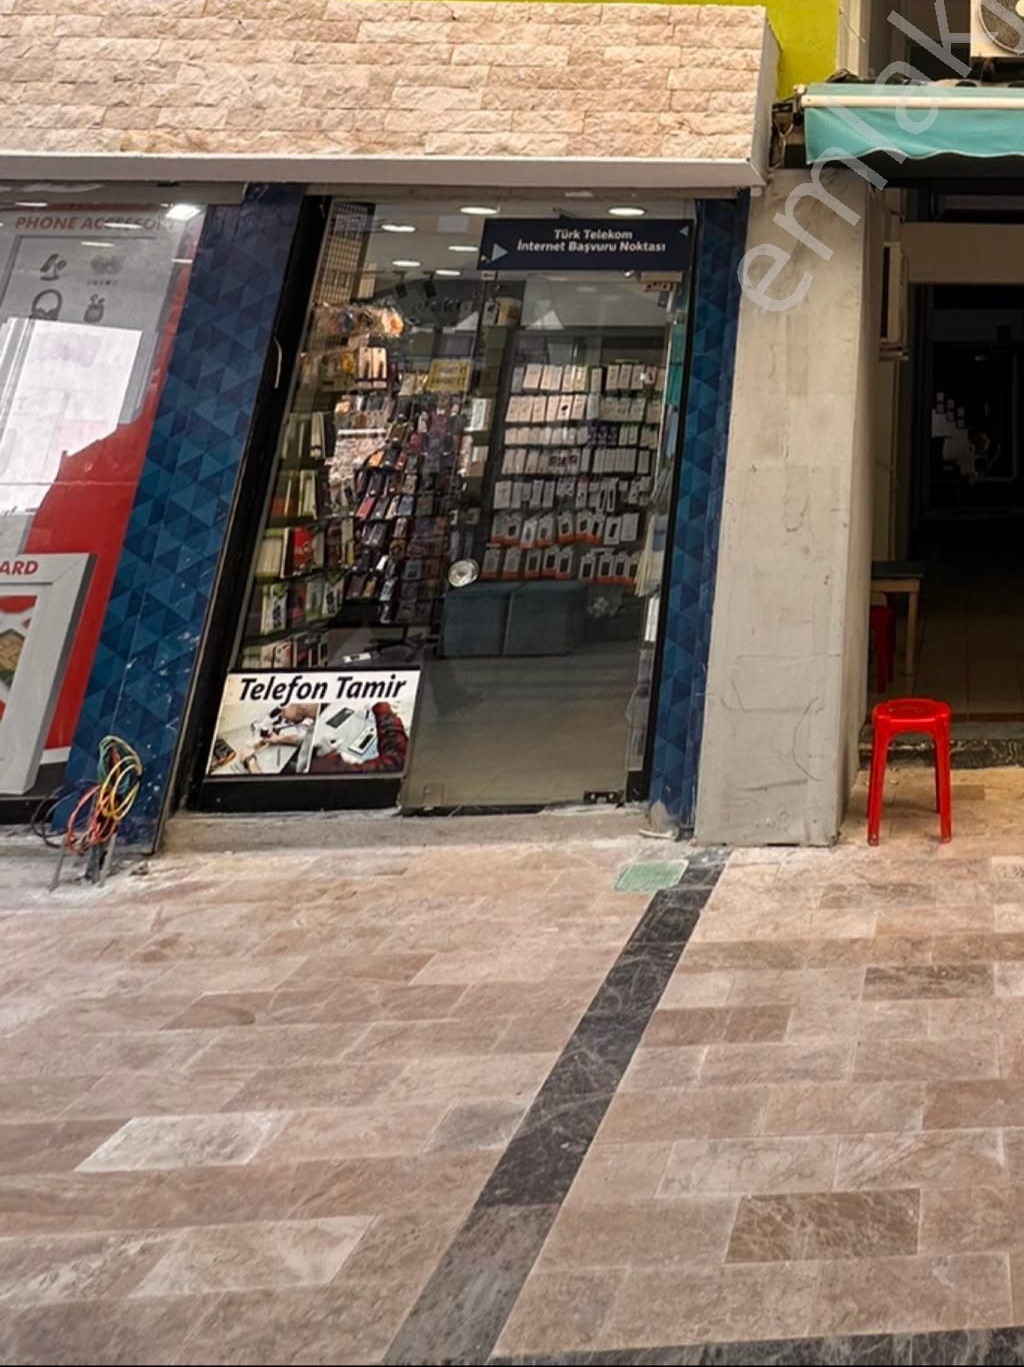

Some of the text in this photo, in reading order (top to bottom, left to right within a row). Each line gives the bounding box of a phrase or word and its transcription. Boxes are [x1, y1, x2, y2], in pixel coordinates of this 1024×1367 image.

[15, 216, 76, 231] PHONE
[554, 228, 633, 240] Türk Telekom
[517, 239, 666, 253] İnternet Başvuru Noktası
[239, 673, 408, 707] Telefon Tamir
